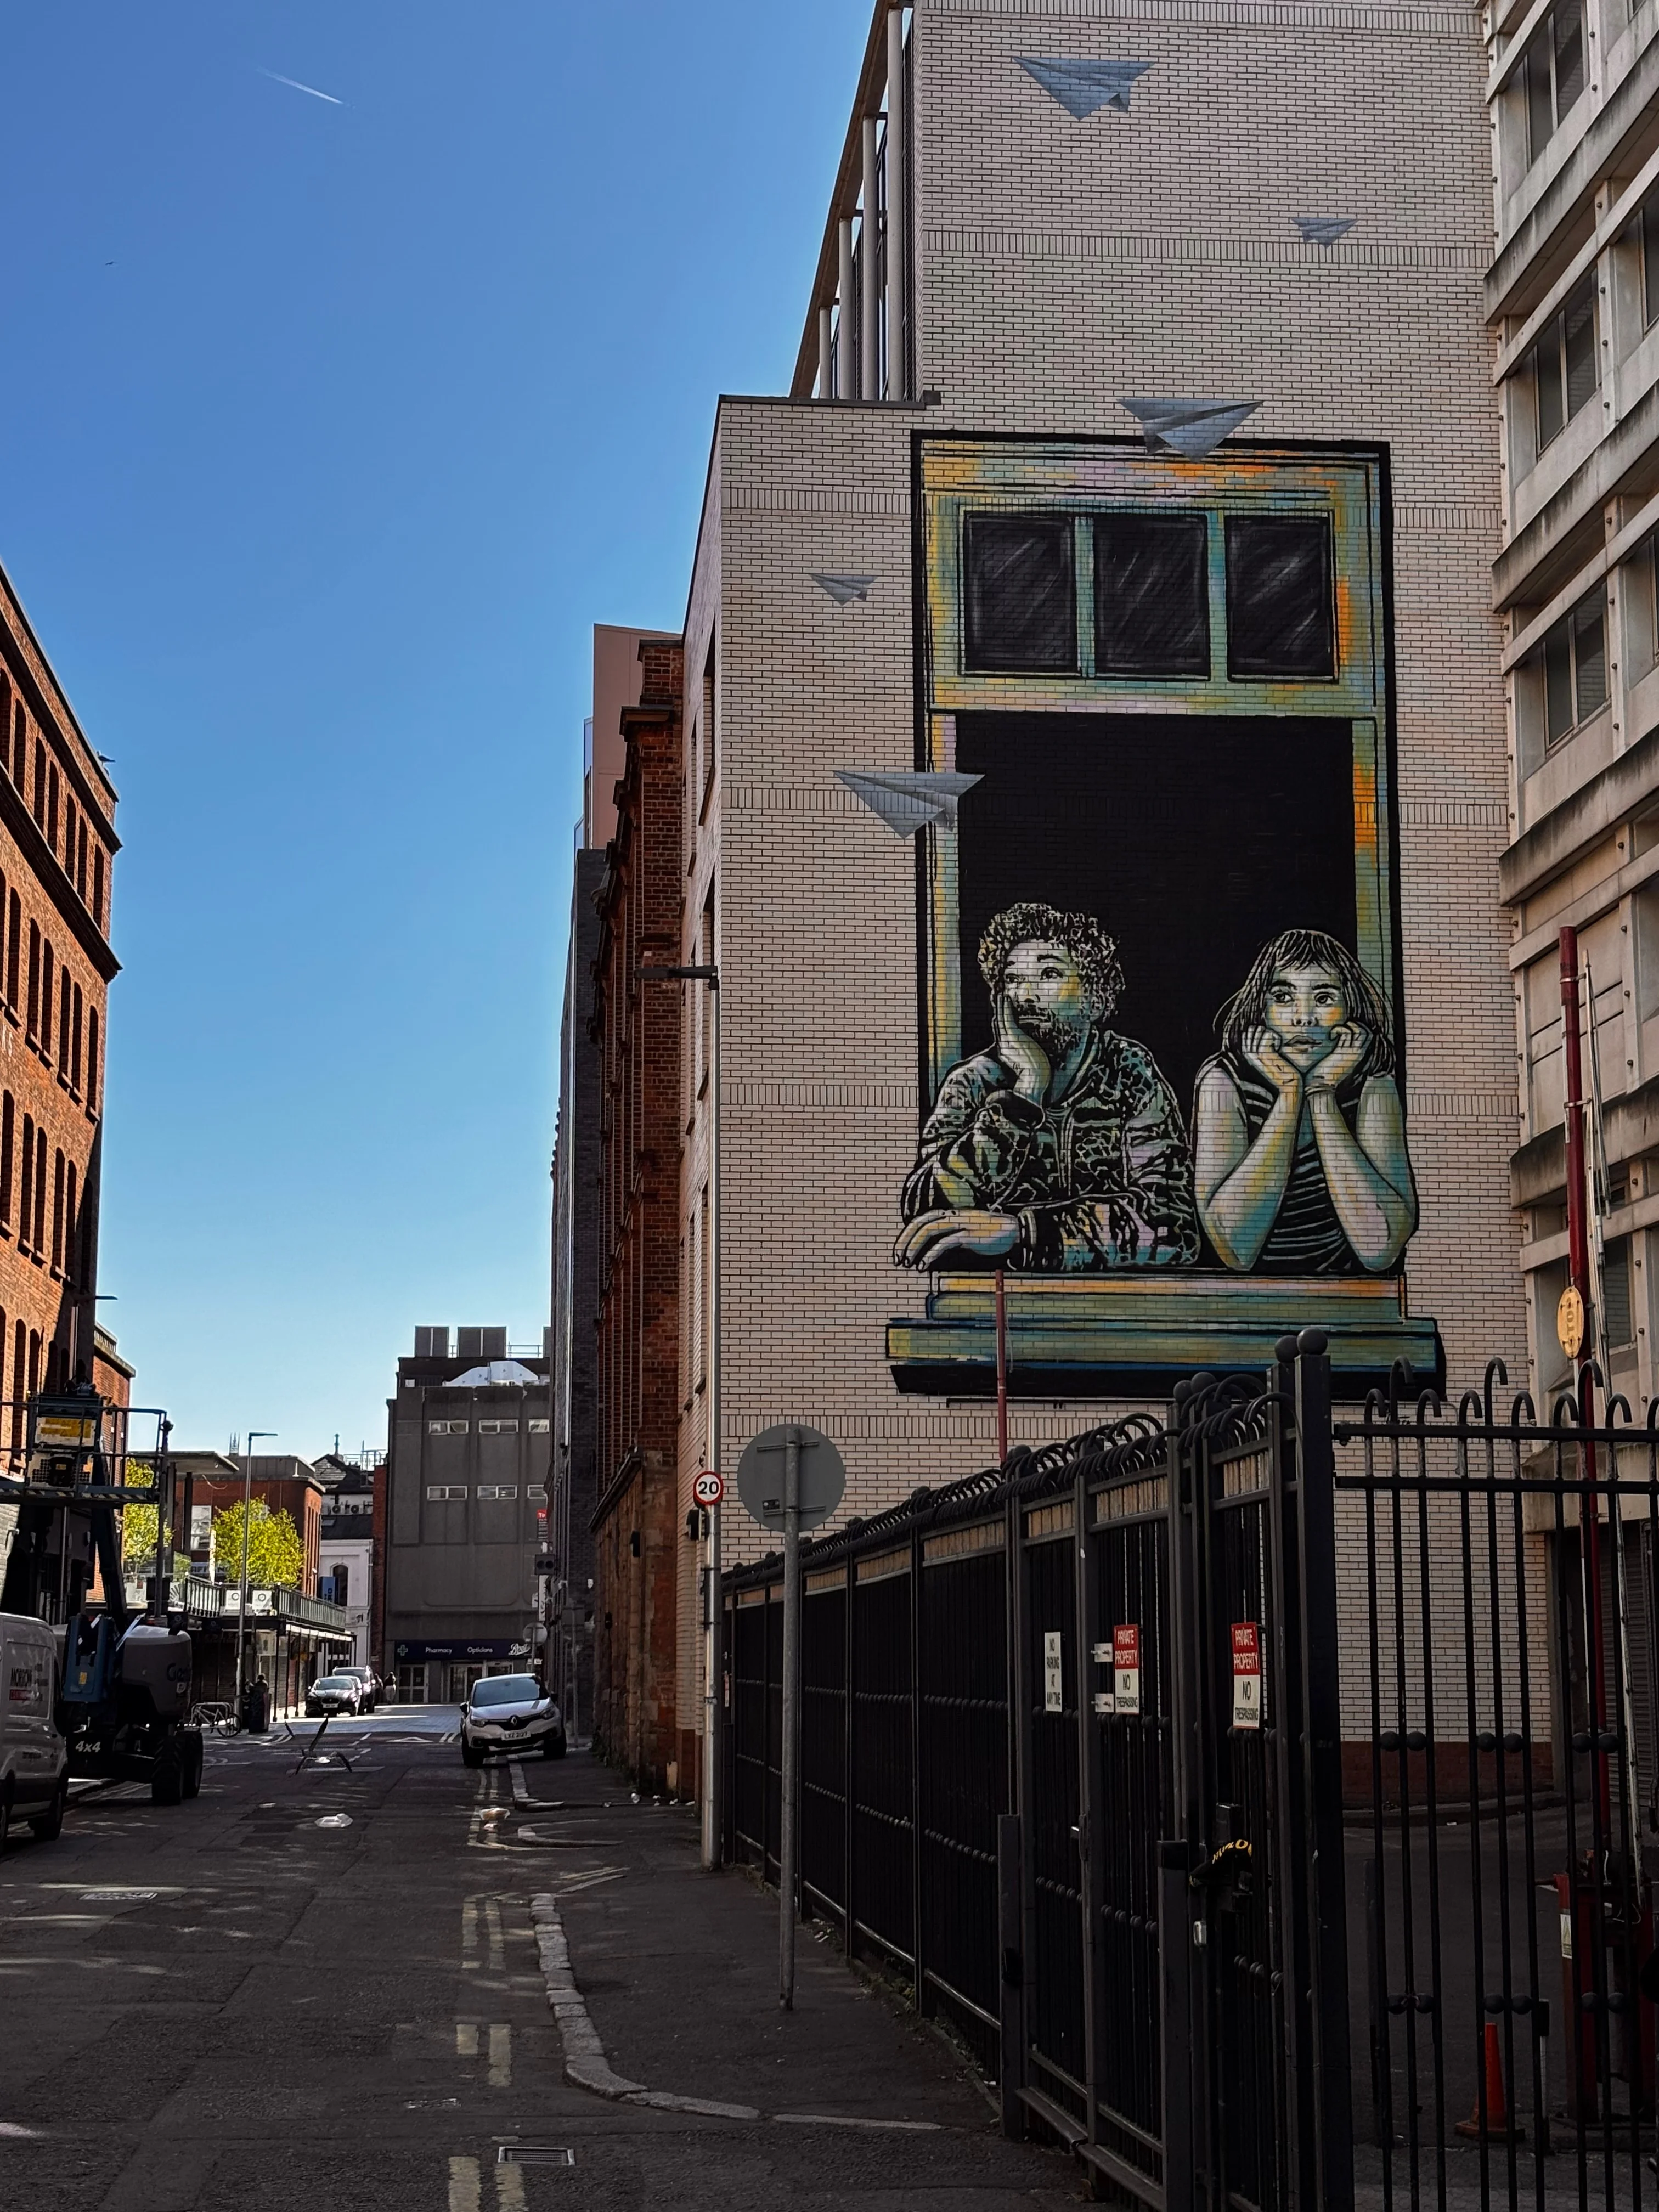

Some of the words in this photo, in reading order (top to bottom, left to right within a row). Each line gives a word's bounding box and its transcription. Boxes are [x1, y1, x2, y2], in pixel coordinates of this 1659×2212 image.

[698, 1481, 719, 1494] 20
[1118, 1629, 1134, 1645] PRIVATE
[1235, 1628, 1254, 1646] PRIVATE
[425, 1646, 453, 1655] Pharmacy
[1115, 1650, 1137, 1664] PROPERTY
[1233, 1652, 1258, 1670] PROPERTY
[1122, 1674, 1131, 1690] NO
[1242, 1680, 1251, 1701] NO
[1116, 1697, 1138, 1707] TRESPASSING
[1235, 1707, 1258, 1721] TRESPASSING
[75, 1740, 101, 1753] 4x4
